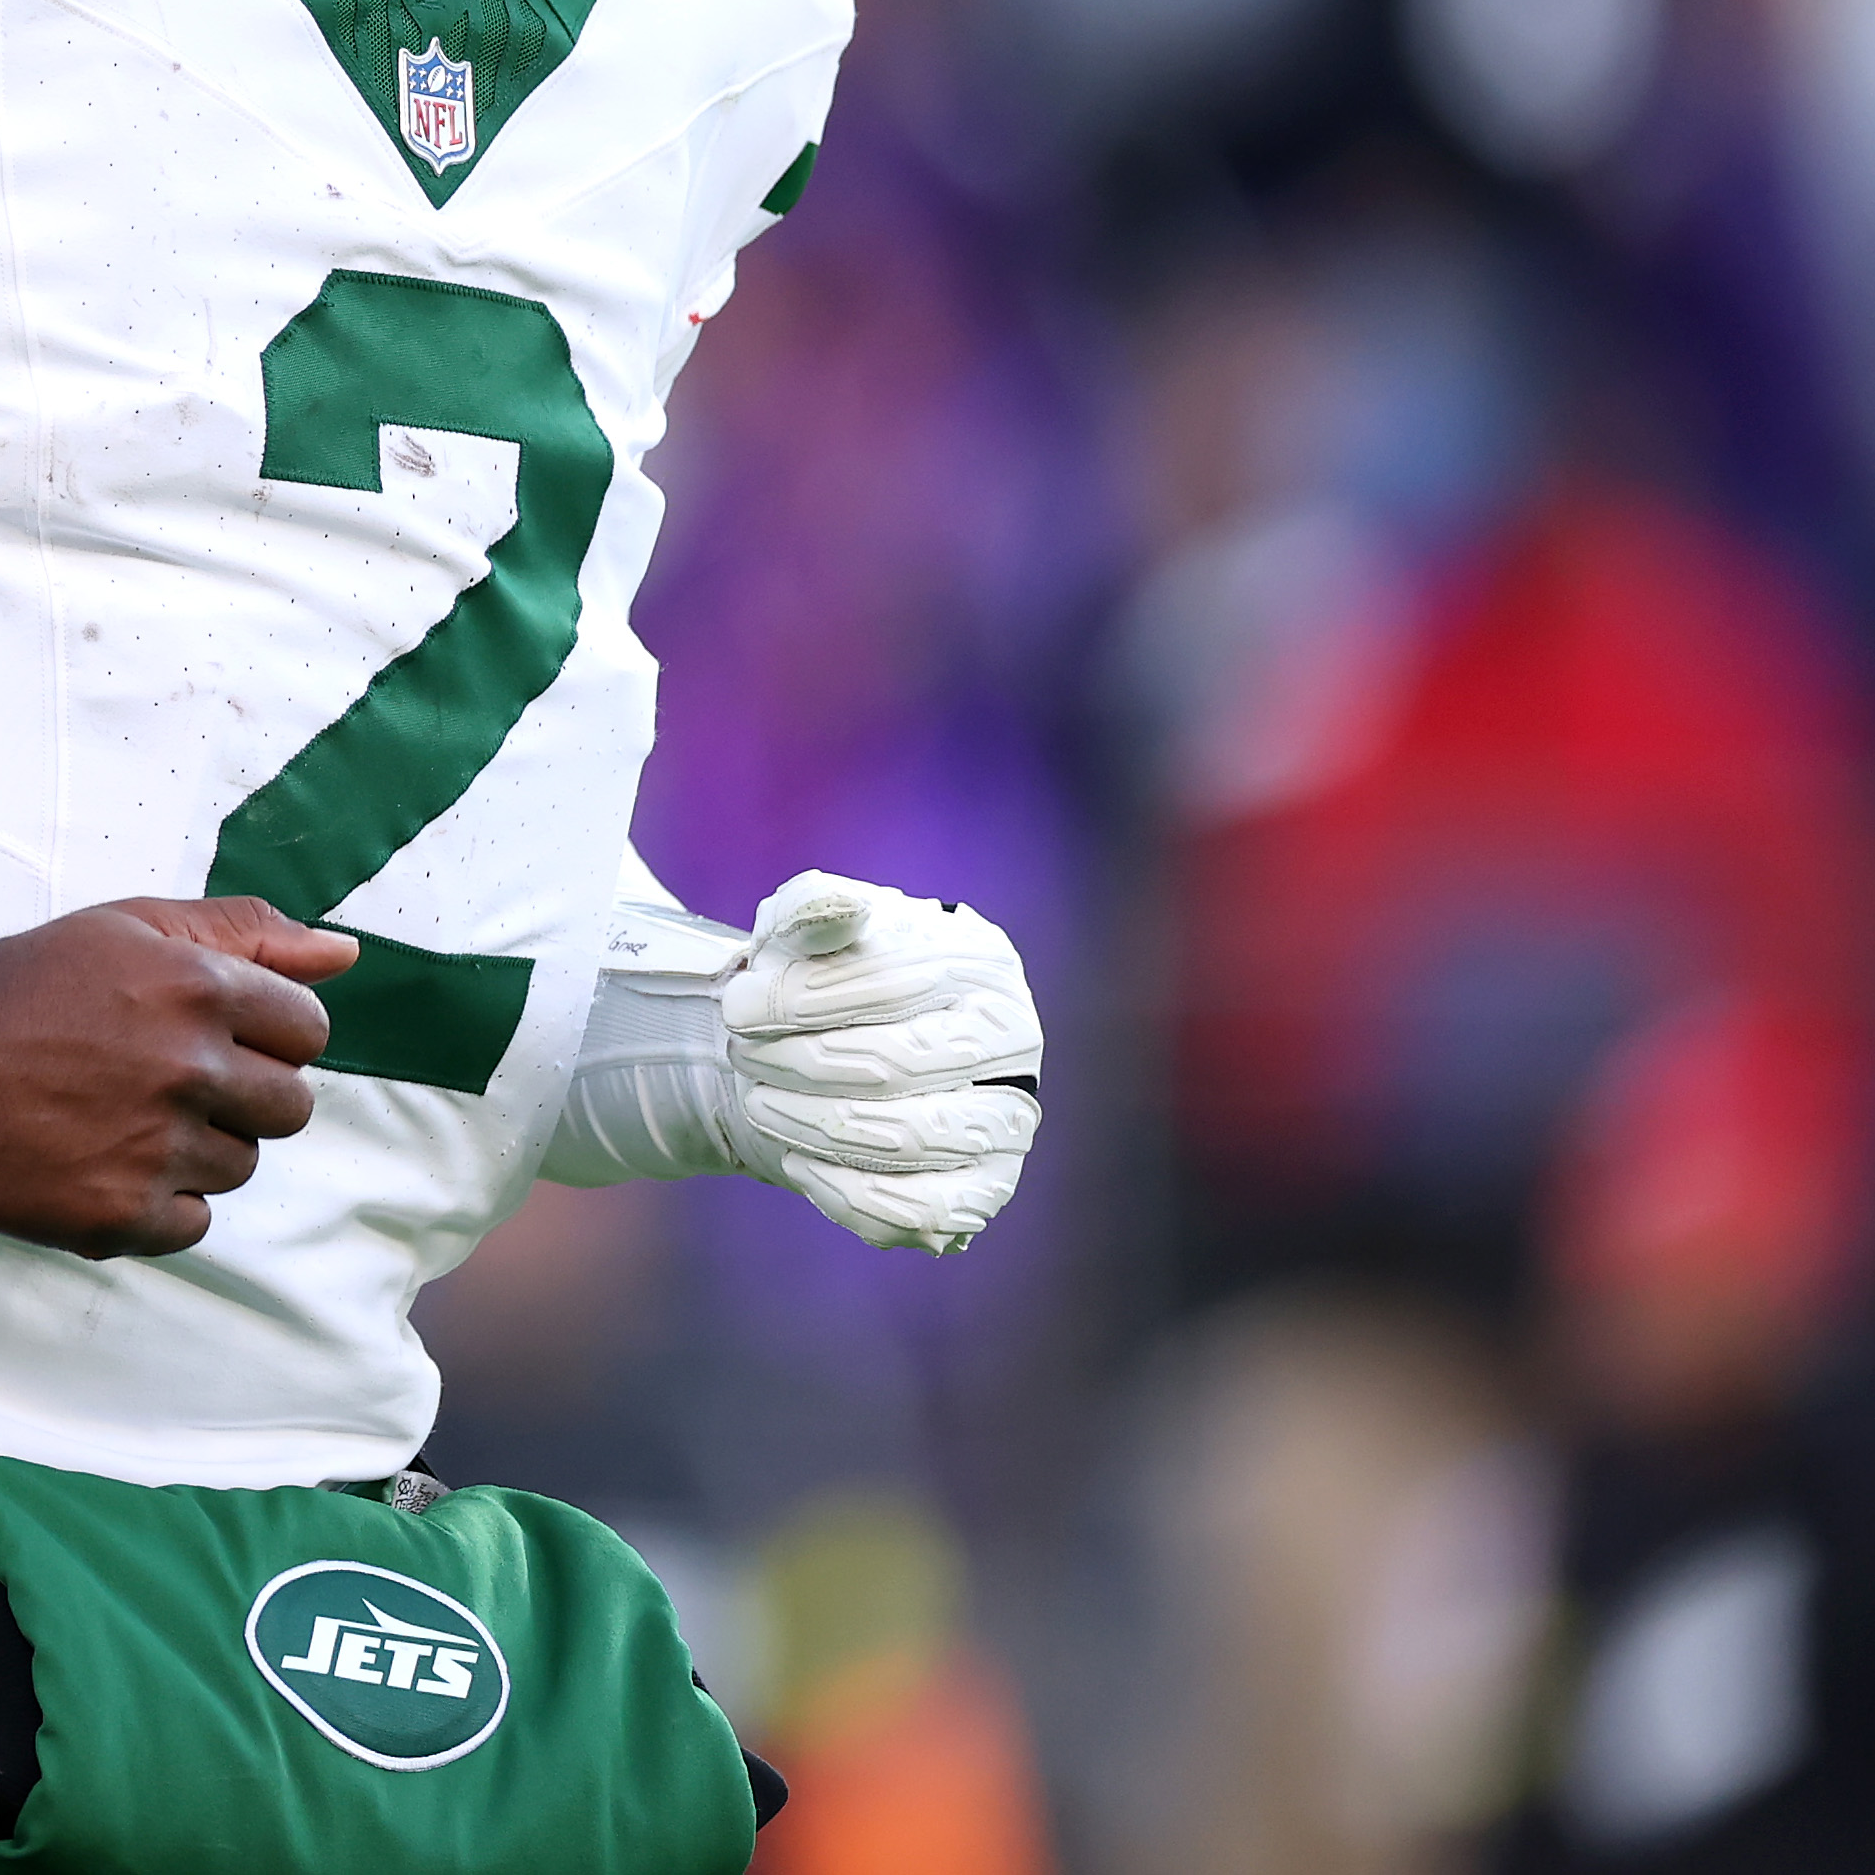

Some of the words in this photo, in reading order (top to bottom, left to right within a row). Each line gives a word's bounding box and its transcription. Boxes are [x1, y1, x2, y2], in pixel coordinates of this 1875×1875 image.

[413, 98, 463, 149] NFL
[204, 268, 614, 1096] 2
[281, 1597, 480, 1699] JETS
